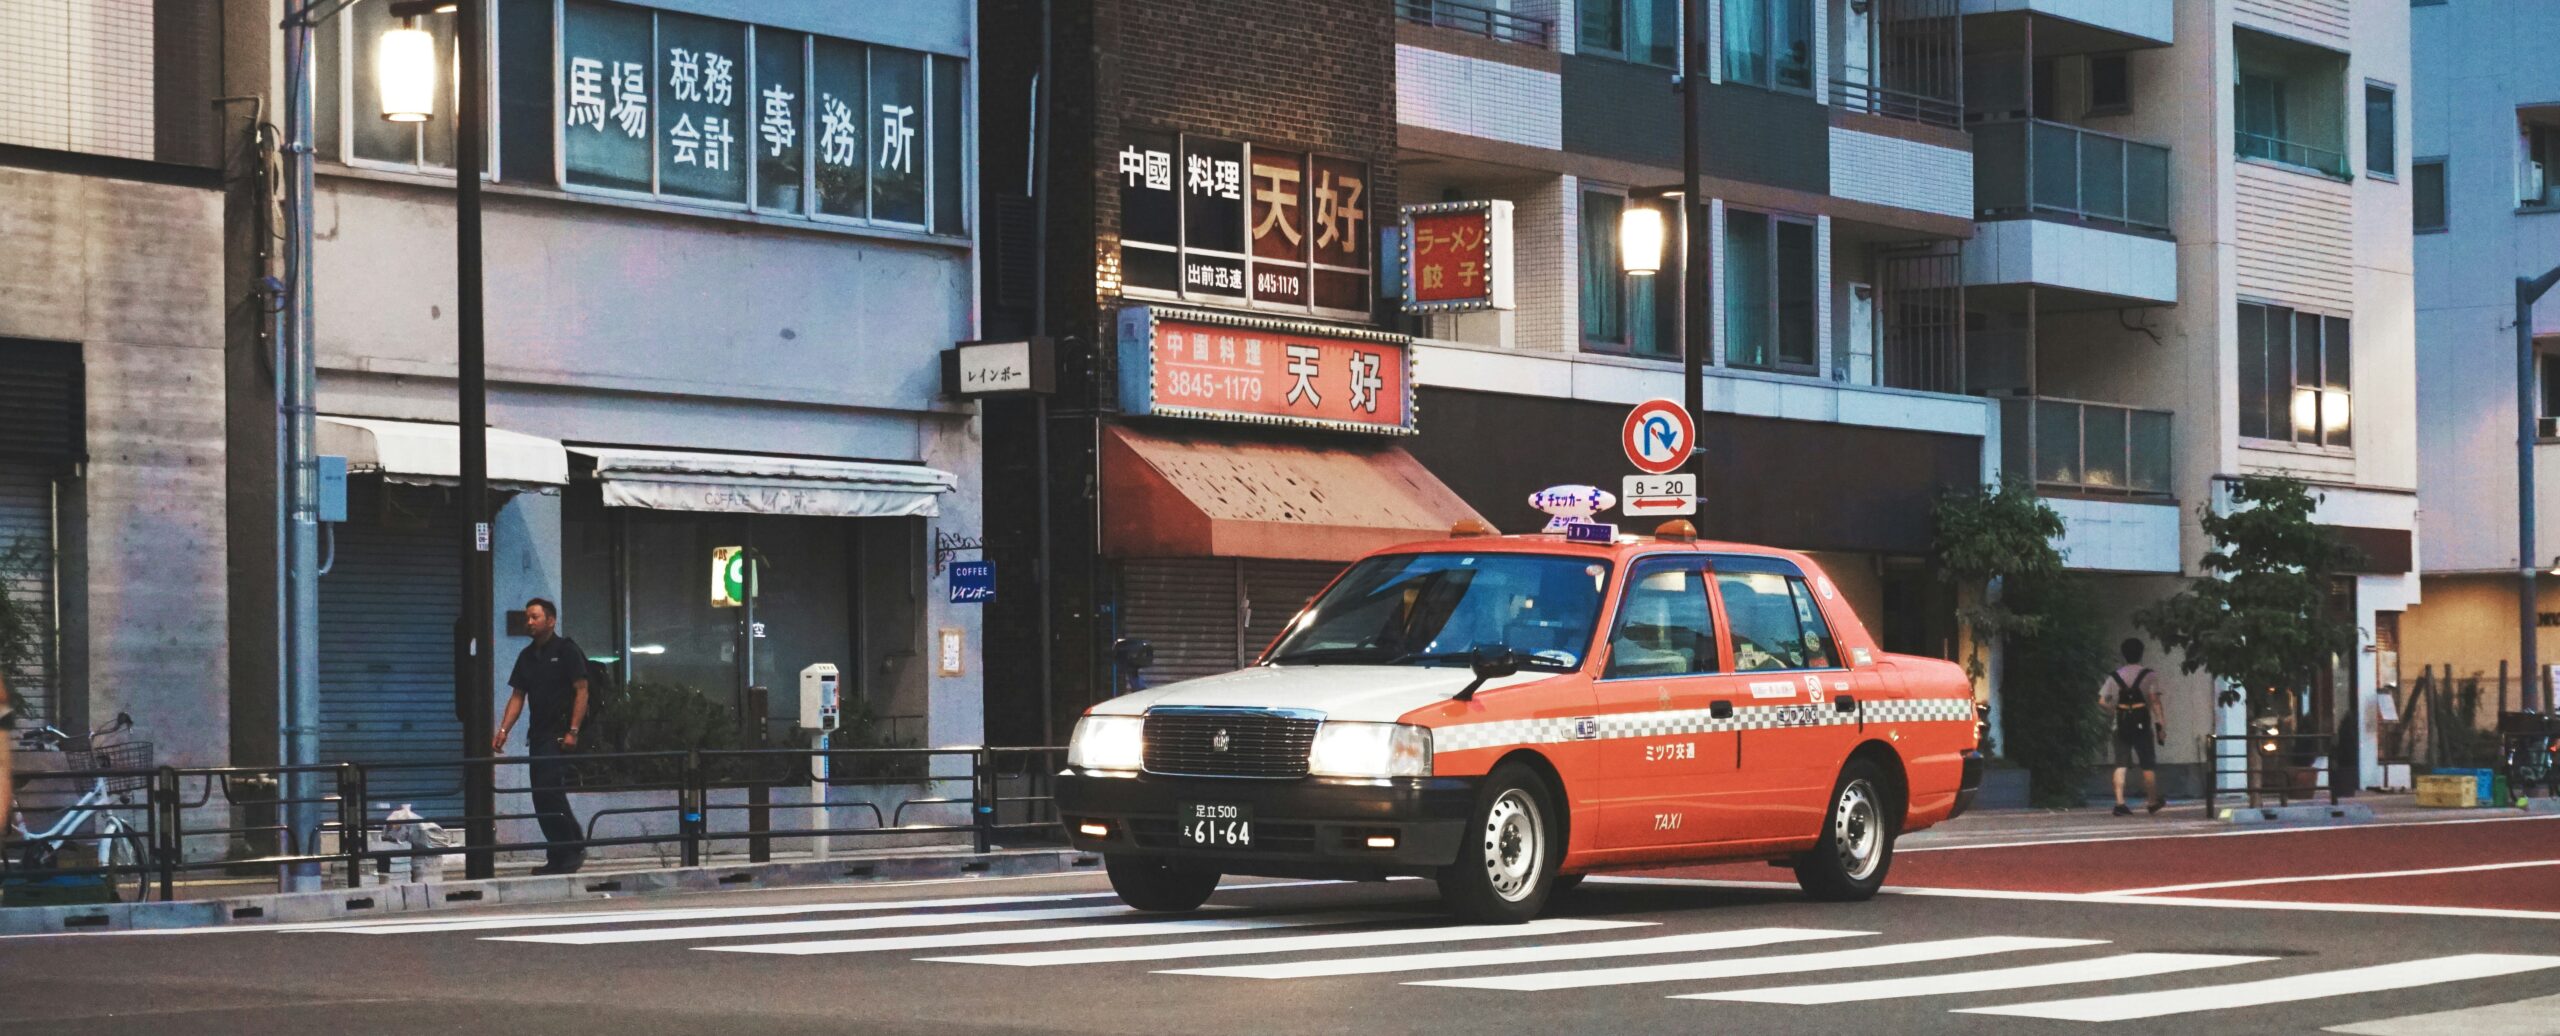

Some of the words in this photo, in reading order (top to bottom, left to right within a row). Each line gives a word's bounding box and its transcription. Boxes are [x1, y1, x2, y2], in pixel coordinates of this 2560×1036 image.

[670, 48, 733, 106] 税務
[568, 57, 647, 139] 馬場
[670, 113, 734, 171] 会計
[760, 84, 914, 173] 事務所
[1252, 163, 1364, 253] 天好
[1417, 226, 1483, 255] ラーメン
[1188, 264, 1242, 290] 出前迅速
[1422, 262, 1479, 290] 餃子
[968, 366, 1021, 383] レインボー
[1168, 370, 1262, 402] 3845-1179
[1286, 344, 1383, 414] 天好
[1548, 493, 1581, 507] チェッカー
[956, 567, 988, 576] COFFEE
[1645, 742, 1695, 761] ミツワ交通
[1195, 820, 1250, 845] 61-64
[1654, 813, 1682, 831] TAXI
